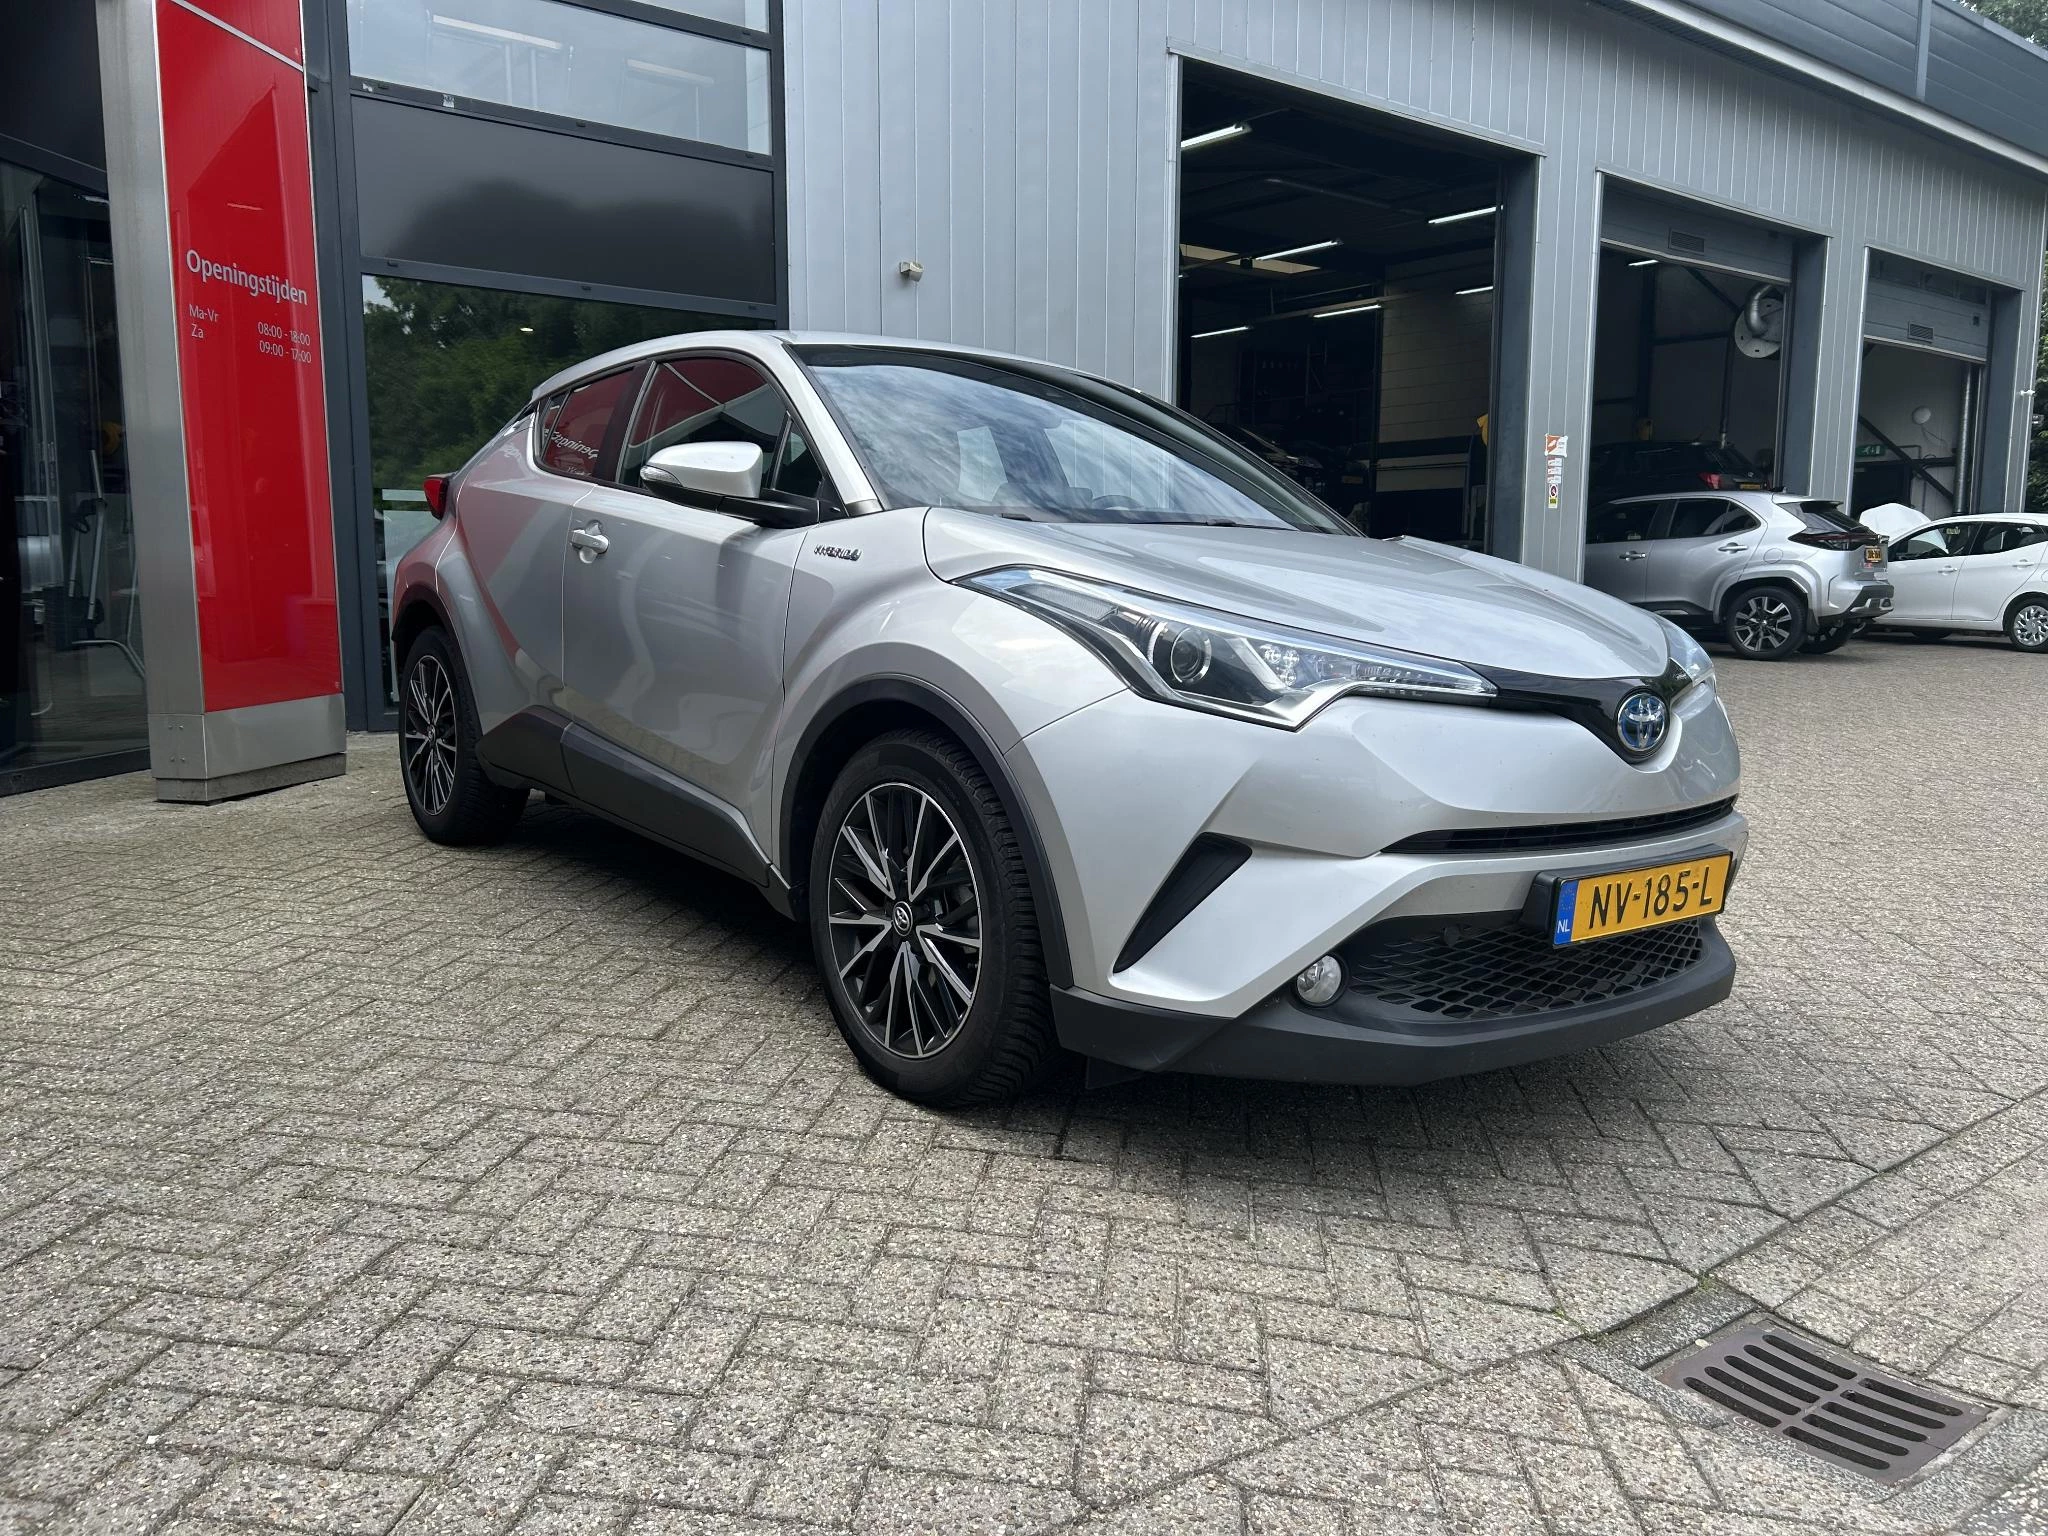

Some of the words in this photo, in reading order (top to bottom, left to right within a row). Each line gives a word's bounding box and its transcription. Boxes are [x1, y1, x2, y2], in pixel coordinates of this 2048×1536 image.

[186, 250, 308, 305] Openingstijden
[189, 304, 219, 323] Ma-Vr
[257, 321, 282, 339] 08:00
[289, 329, 311, 346] 18:00
[191, 324, 204, 339] Za
[259, 340, 284, 357] 09:00
[291, 347, 312, 363] 17:00
[1557, 919, 1571, 934] NL
[1588, 866, 1713, 930] NV-185-L
